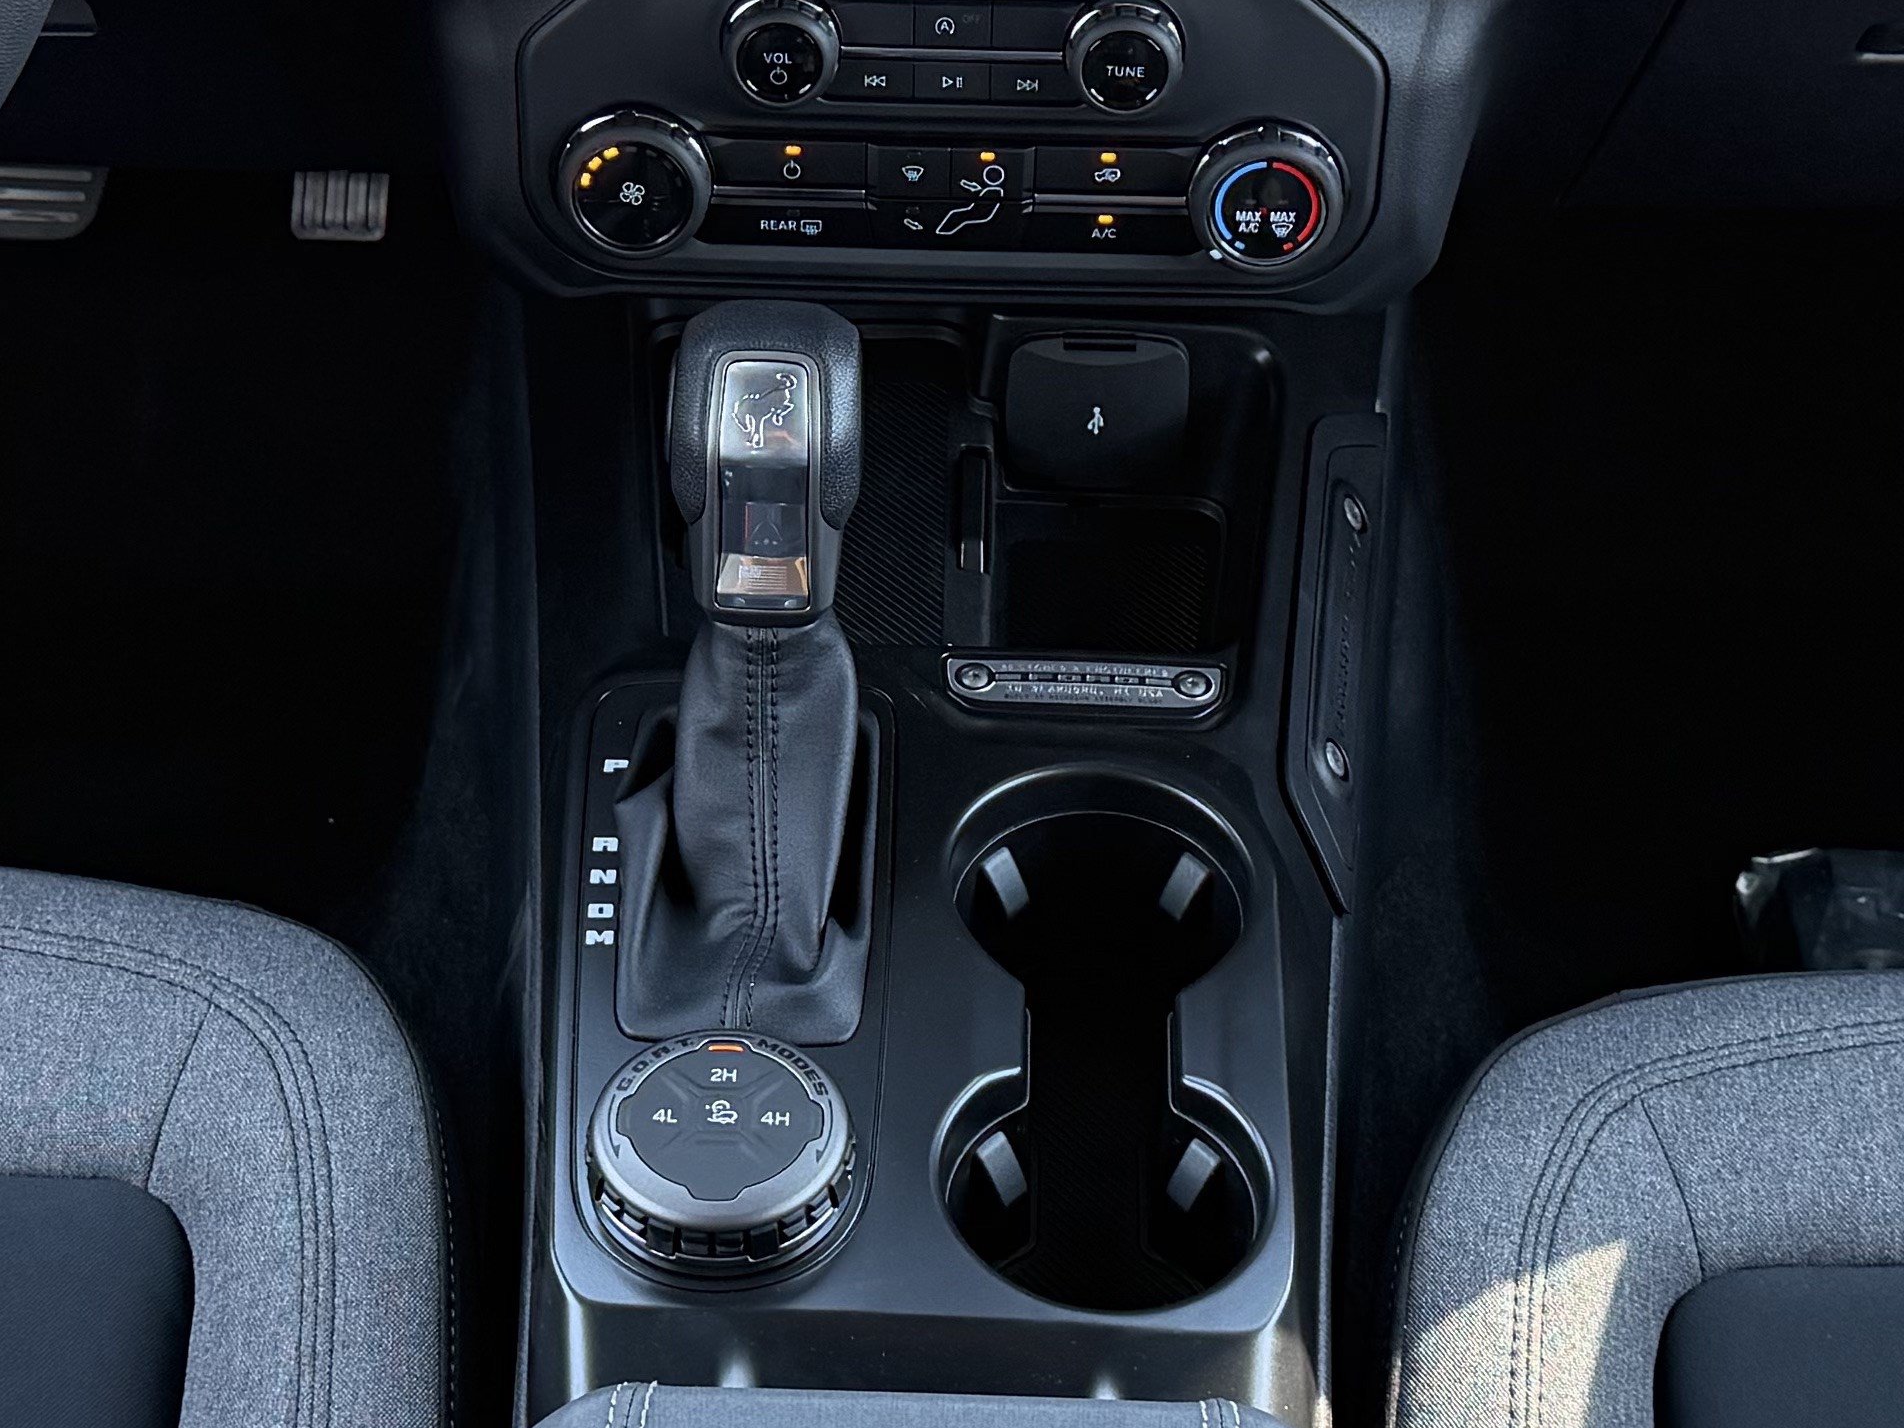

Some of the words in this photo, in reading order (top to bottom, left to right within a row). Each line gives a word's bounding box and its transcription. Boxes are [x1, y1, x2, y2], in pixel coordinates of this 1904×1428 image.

[763, 52, 792, 63] VOL
[1106, 65, 1146, 78] TUNE
[1236, 211, 1262, 222] MAX
[1269, 212, 1296, 223] MAX
[760, 220, 797, 231] REAR
[1238, 222, 1260, 233] A/C
[1091, 228, 1117, 239] A/C
[603, 759, 629, 772] P
[589, 869, 617, 884] N
[585, 930, 614, 945] M
[757, 1039, 828, 1096] MODES
[710, 1069, 737, 1083] 2H
[653, 1109, 677, 1123] 4L
[760, 1112, 790, 1126] 4H
